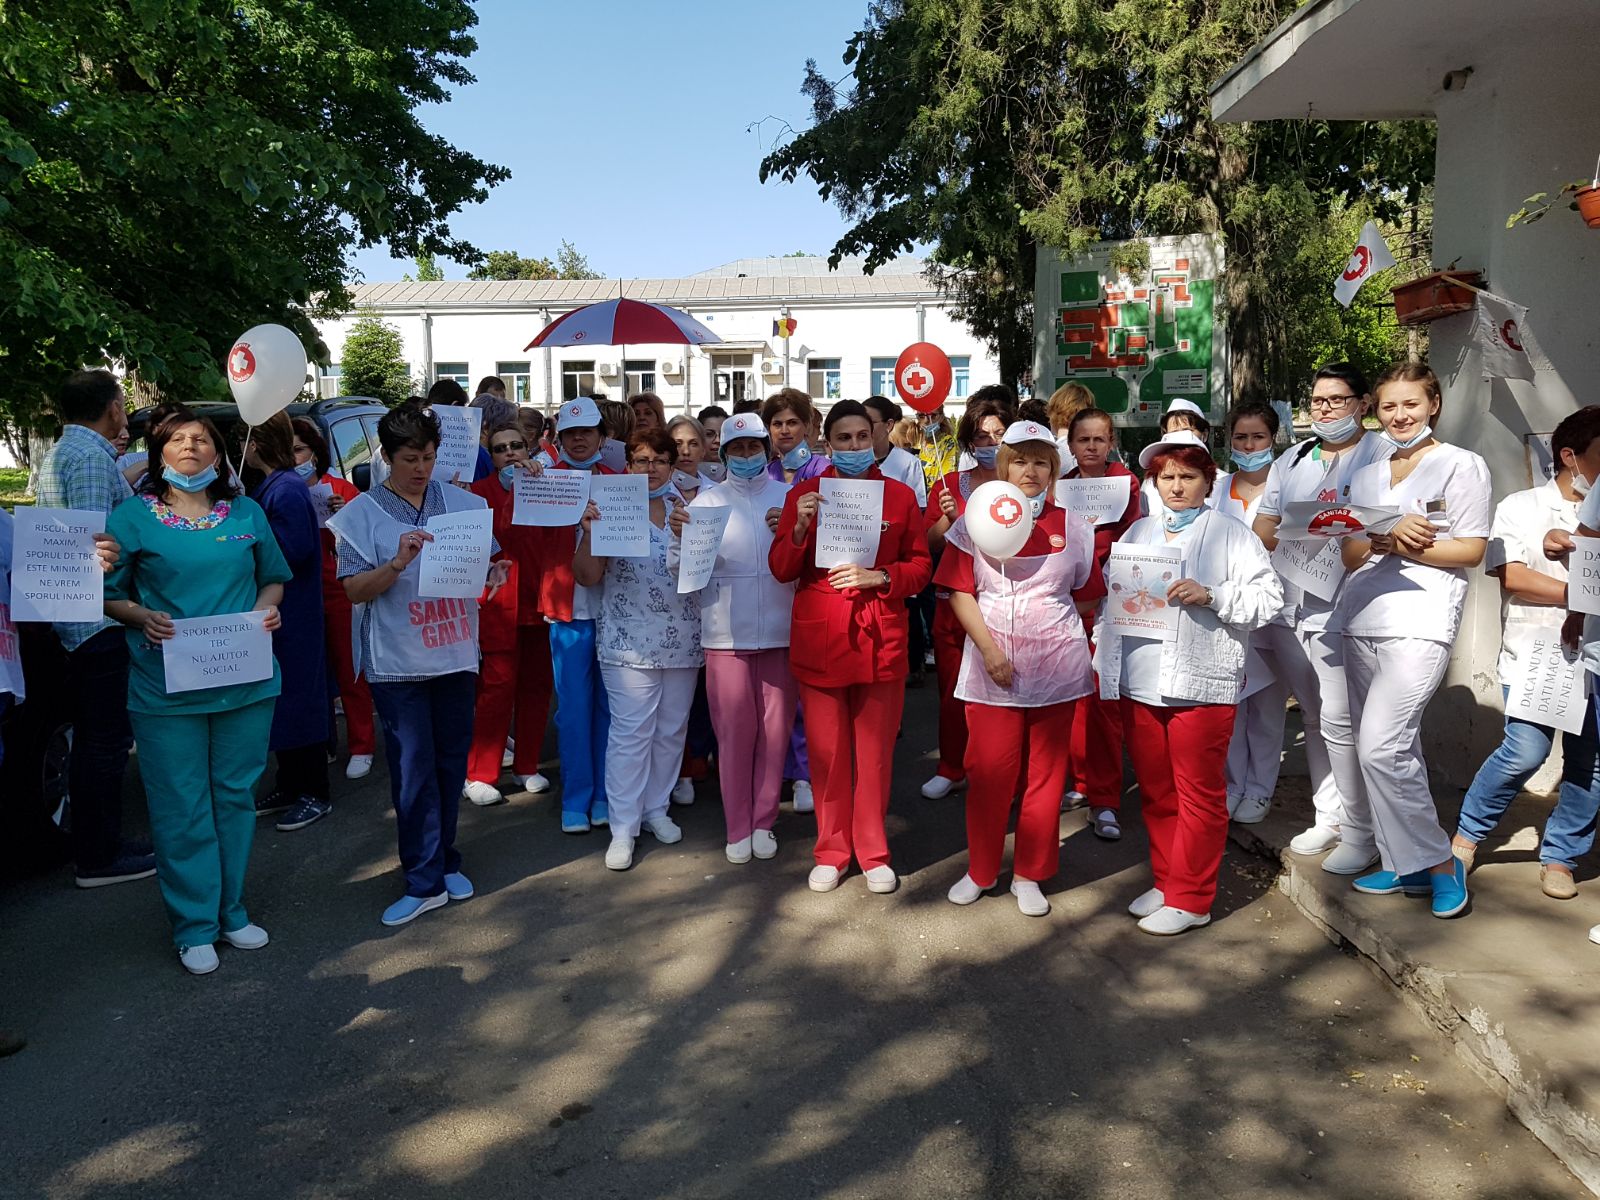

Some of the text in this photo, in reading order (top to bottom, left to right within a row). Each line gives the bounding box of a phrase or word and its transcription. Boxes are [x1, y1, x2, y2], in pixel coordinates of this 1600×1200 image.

[1319, 510, 1348, 520] SANITAS
[35, 524, 88, 534] RISCUL ESTE
[44, 538, 79, 548] MAXIM,
[1325, 543, 1339, 555] NE
[26, 550, 61, 559] SPORUL
[1290, 555, 1299, 567] NE
[1300, 562, 1329, 581] LUATI
[182, 623, 253, 637] SPOR PENTRU
[210, 639, 230, 647] TBC
[192, 650, 249, 664] NU AJUTOR
[202, 664, 240, 675] SOCIAL
[1520, 640, 1545, 707] DACA NU NE
[1538, 643, 1561, 713] DATI MACAR
[1560, 683, 1572, 700] NE
[1556, 700, 1567, 717] NU
